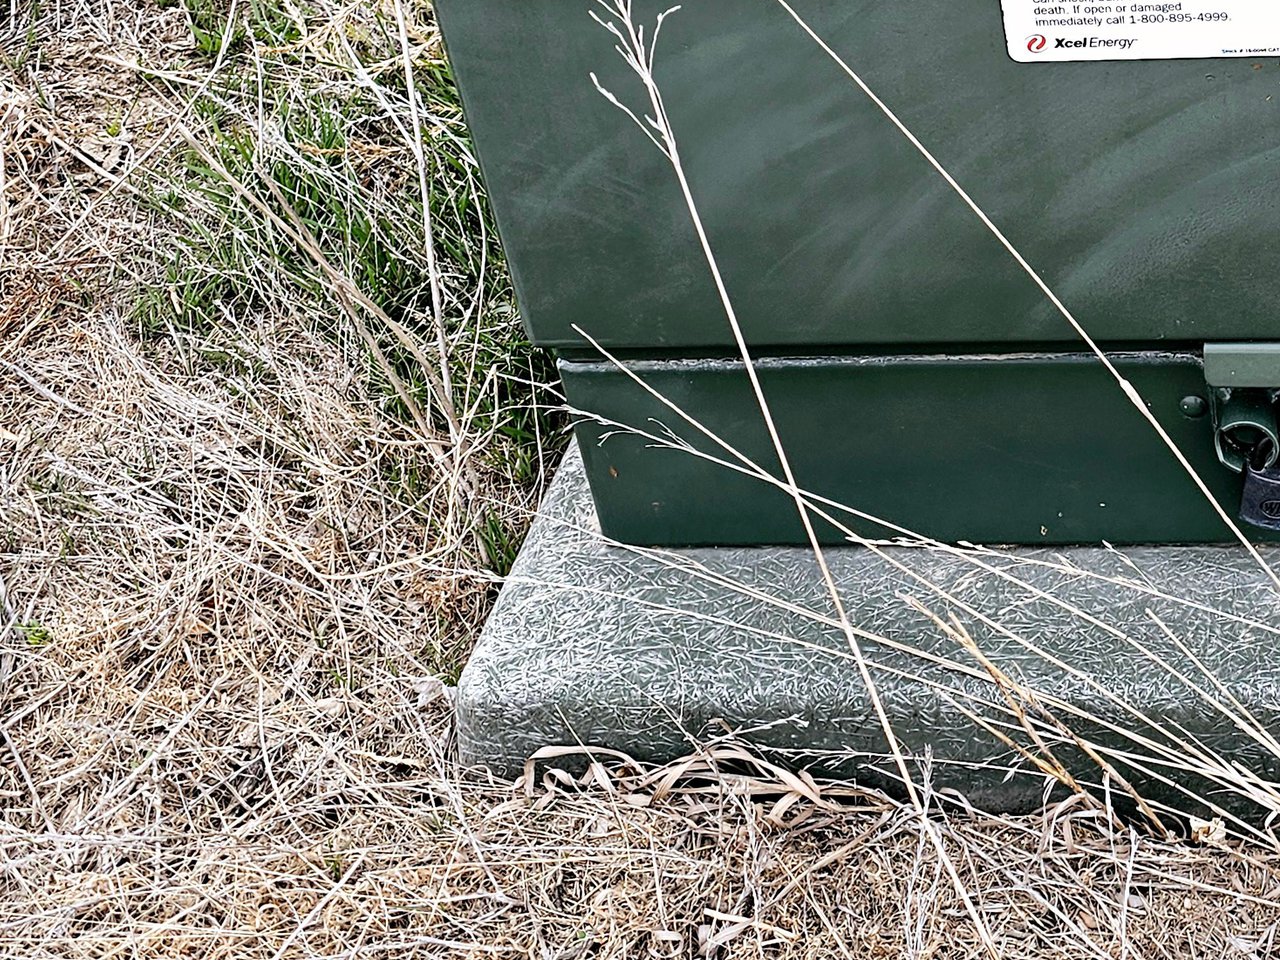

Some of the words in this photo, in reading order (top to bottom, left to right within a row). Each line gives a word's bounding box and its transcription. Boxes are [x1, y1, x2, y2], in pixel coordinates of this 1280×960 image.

[1034, 6, 1069, 15] death.
[1073, 5, 1080, 14] If
[1084, 5, 1112, 15] open
[1130, 3, 1182, 13] damaged
[1035, 16, 1102, 27] immediately
[1106, 16, 1125, 25] call
[1054, 37, 1087, 48] Xcel
